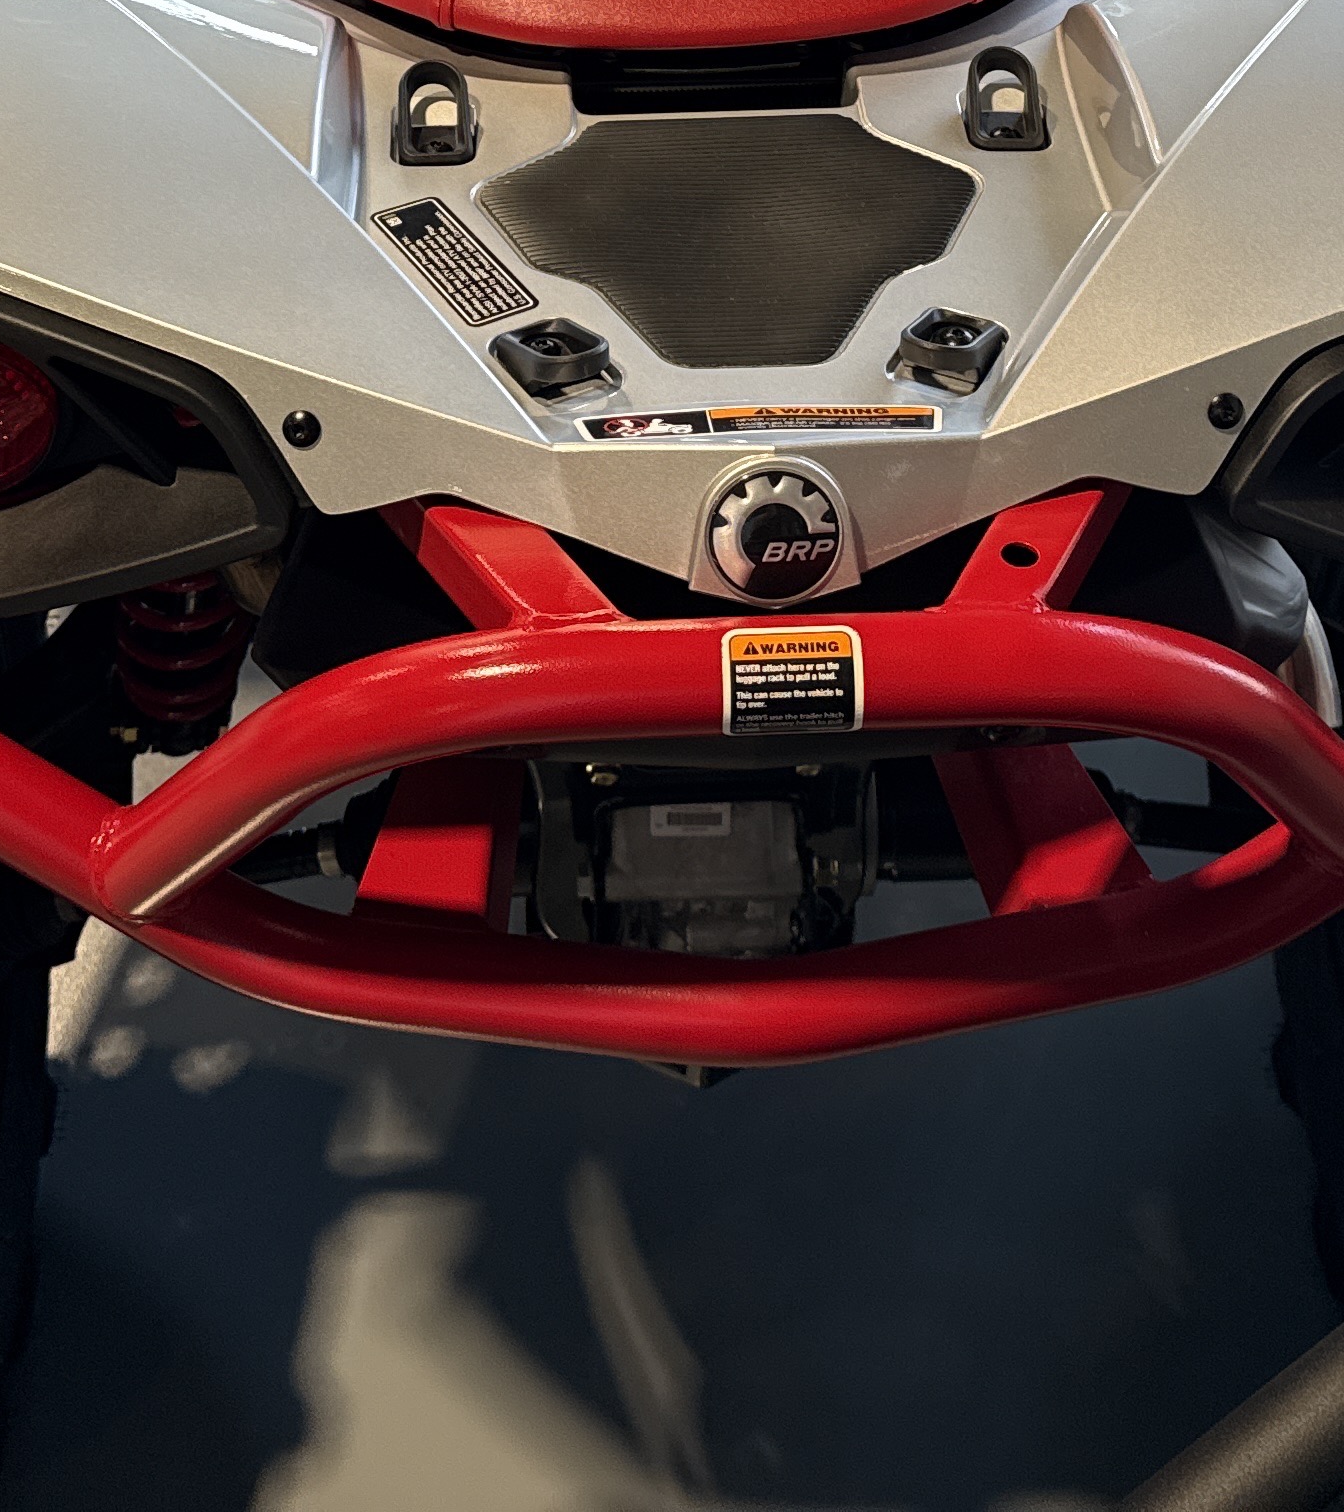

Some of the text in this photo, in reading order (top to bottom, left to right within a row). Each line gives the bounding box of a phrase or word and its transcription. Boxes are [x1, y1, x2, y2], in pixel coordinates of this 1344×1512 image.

[779, 407, 890, 416] WARNING
[761, 538, 836, 563] BRP
[760, 641, 839, 654] WARNING
[736, 664, 760, 673] NEVER
[762, 664, 786, 672] attach
[787, 663, 804, 671] here
[827, 662, 839, 670] the
[736, 675, 767, 684] luggage
[767, 674, 785, 682] rack
[796, 673, 810, 683] pull
[818, 672, 837, 680] load.
[736, 691, 752, 699] This
[807, 689, 834, 697] vehicle
[736, 701, 746, 710] tip
